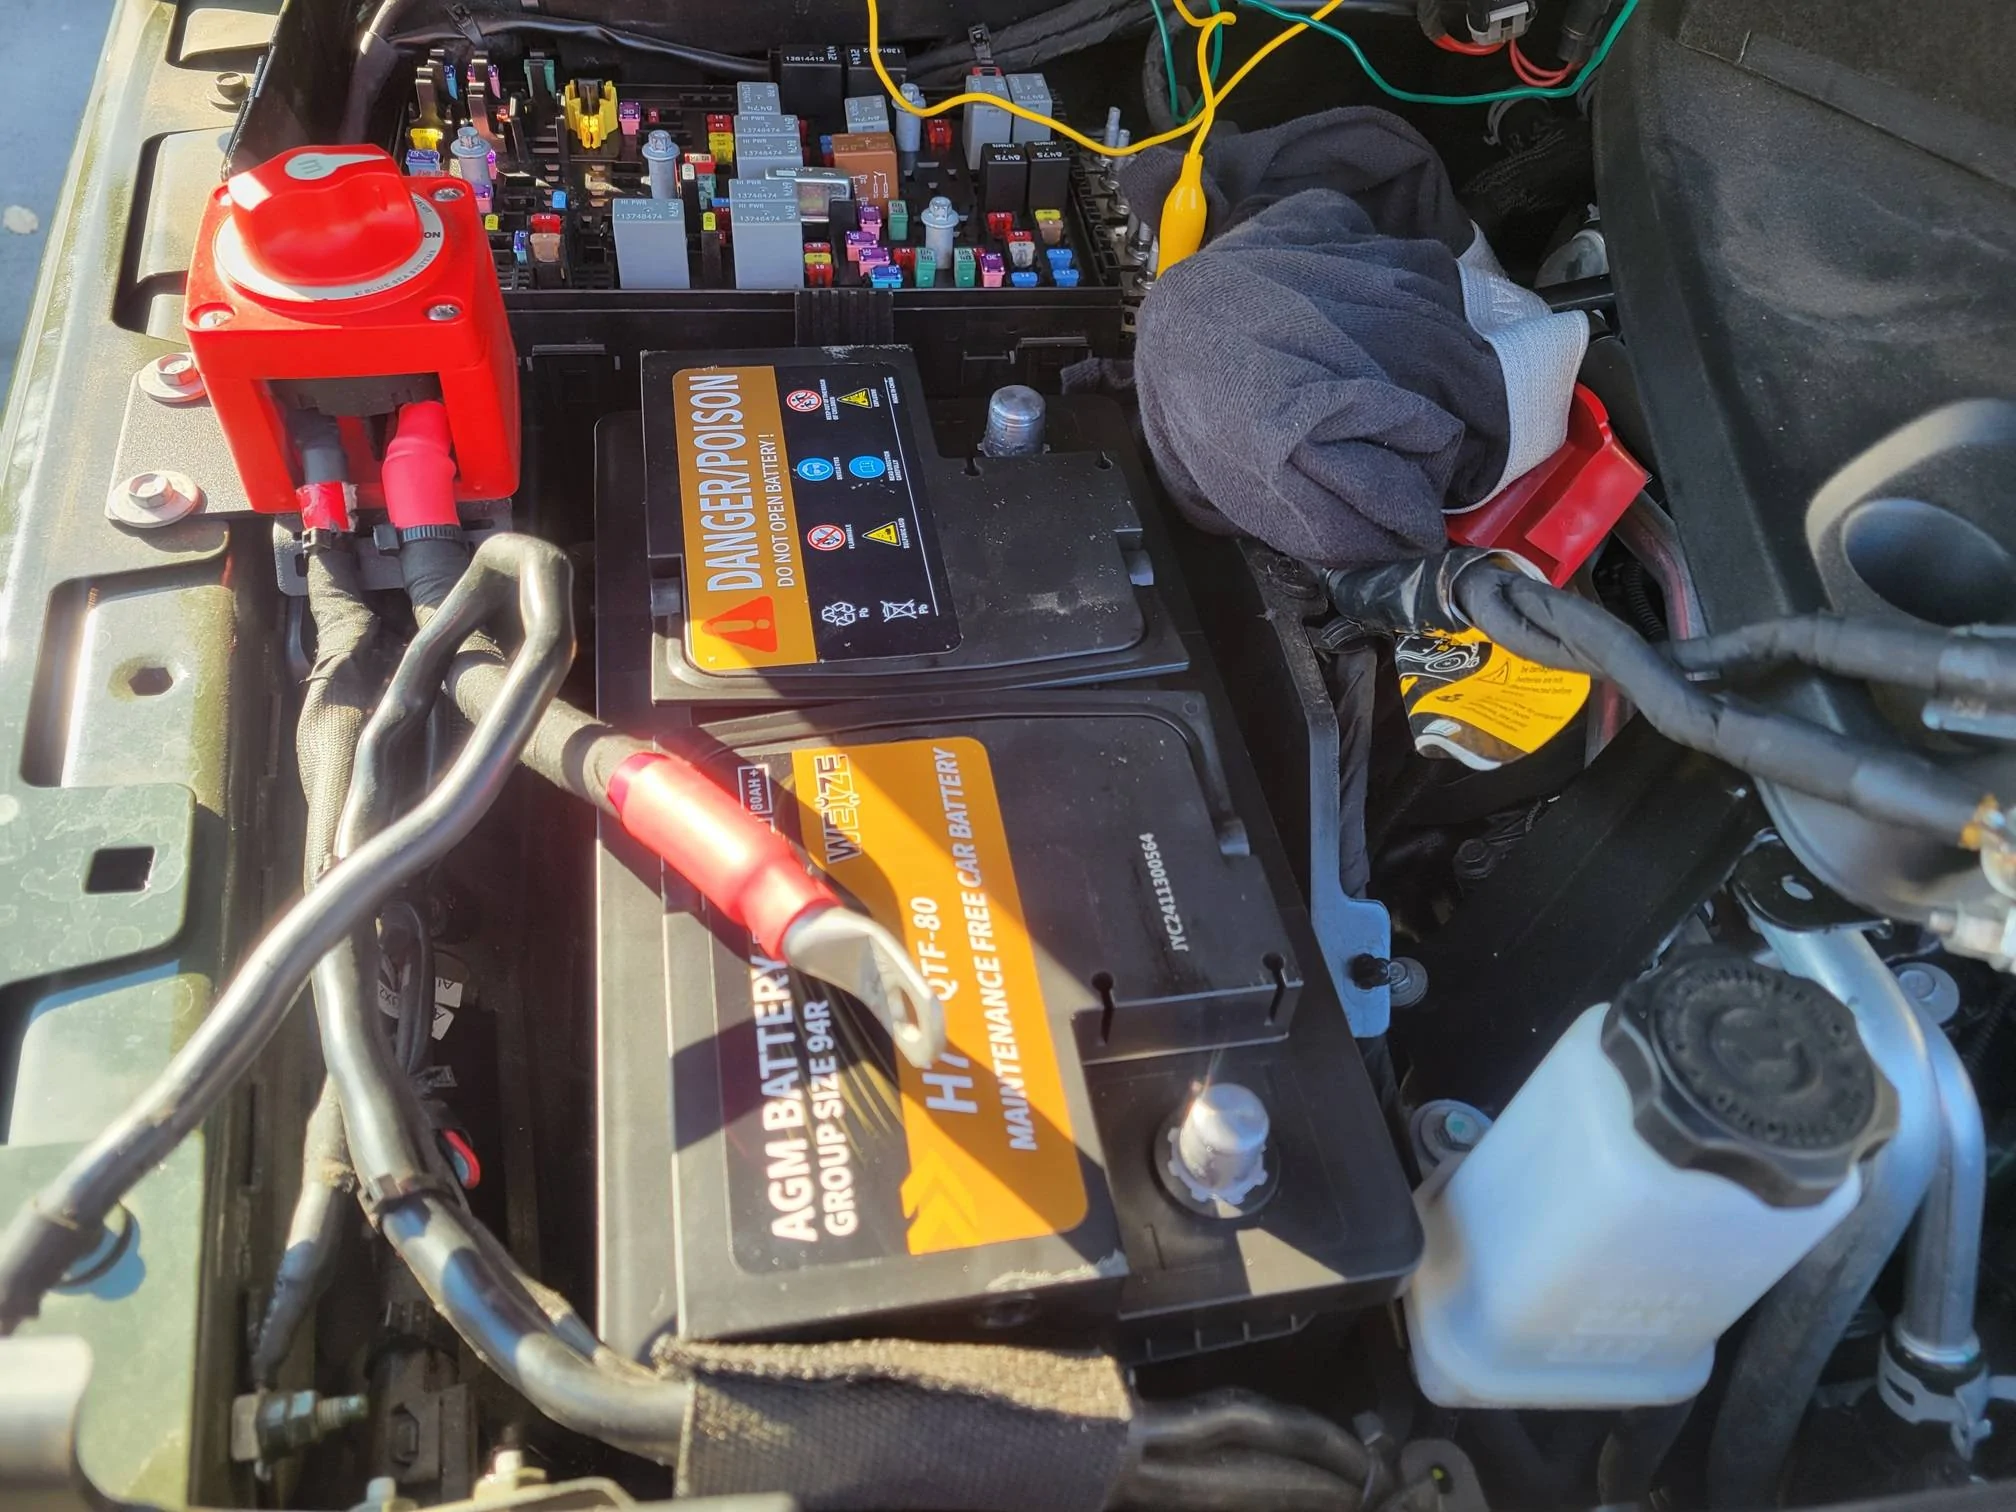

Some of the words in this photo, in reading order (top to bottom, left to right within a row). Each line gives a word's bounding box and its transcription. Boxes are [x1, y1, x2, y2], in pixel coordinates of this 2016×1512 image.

[424, 231, 441, 239] ON
[688, 374, 763, 592] DANGER/POISON
[766, 494, 787, 532] OPEN
[771, 534, 792, 564] NOT
[775, 565, 795, 588] DO
[859, 607, 870, 618] Pb
[918, 603, 929, 615] Pb
[813, 754, 863, 865] WEIZE
[932, 746, 973, 840] BATTERY
[951, 842, 983, 889] CAR
[1138, 832, 1190, 953] JYC2411300564
[960, 891, 997, 952] FREE
[750, 955, 805, 1132] BATTERY
[803, 999, 834, 1053] 94R
[973, 955, 1039, 1151] MAINTENANCE
[809, 1056, 844, 1121] SIZE
[764, 1137, 819, 1243] AGM
[815, 1122, 859, 1237] GROUP
